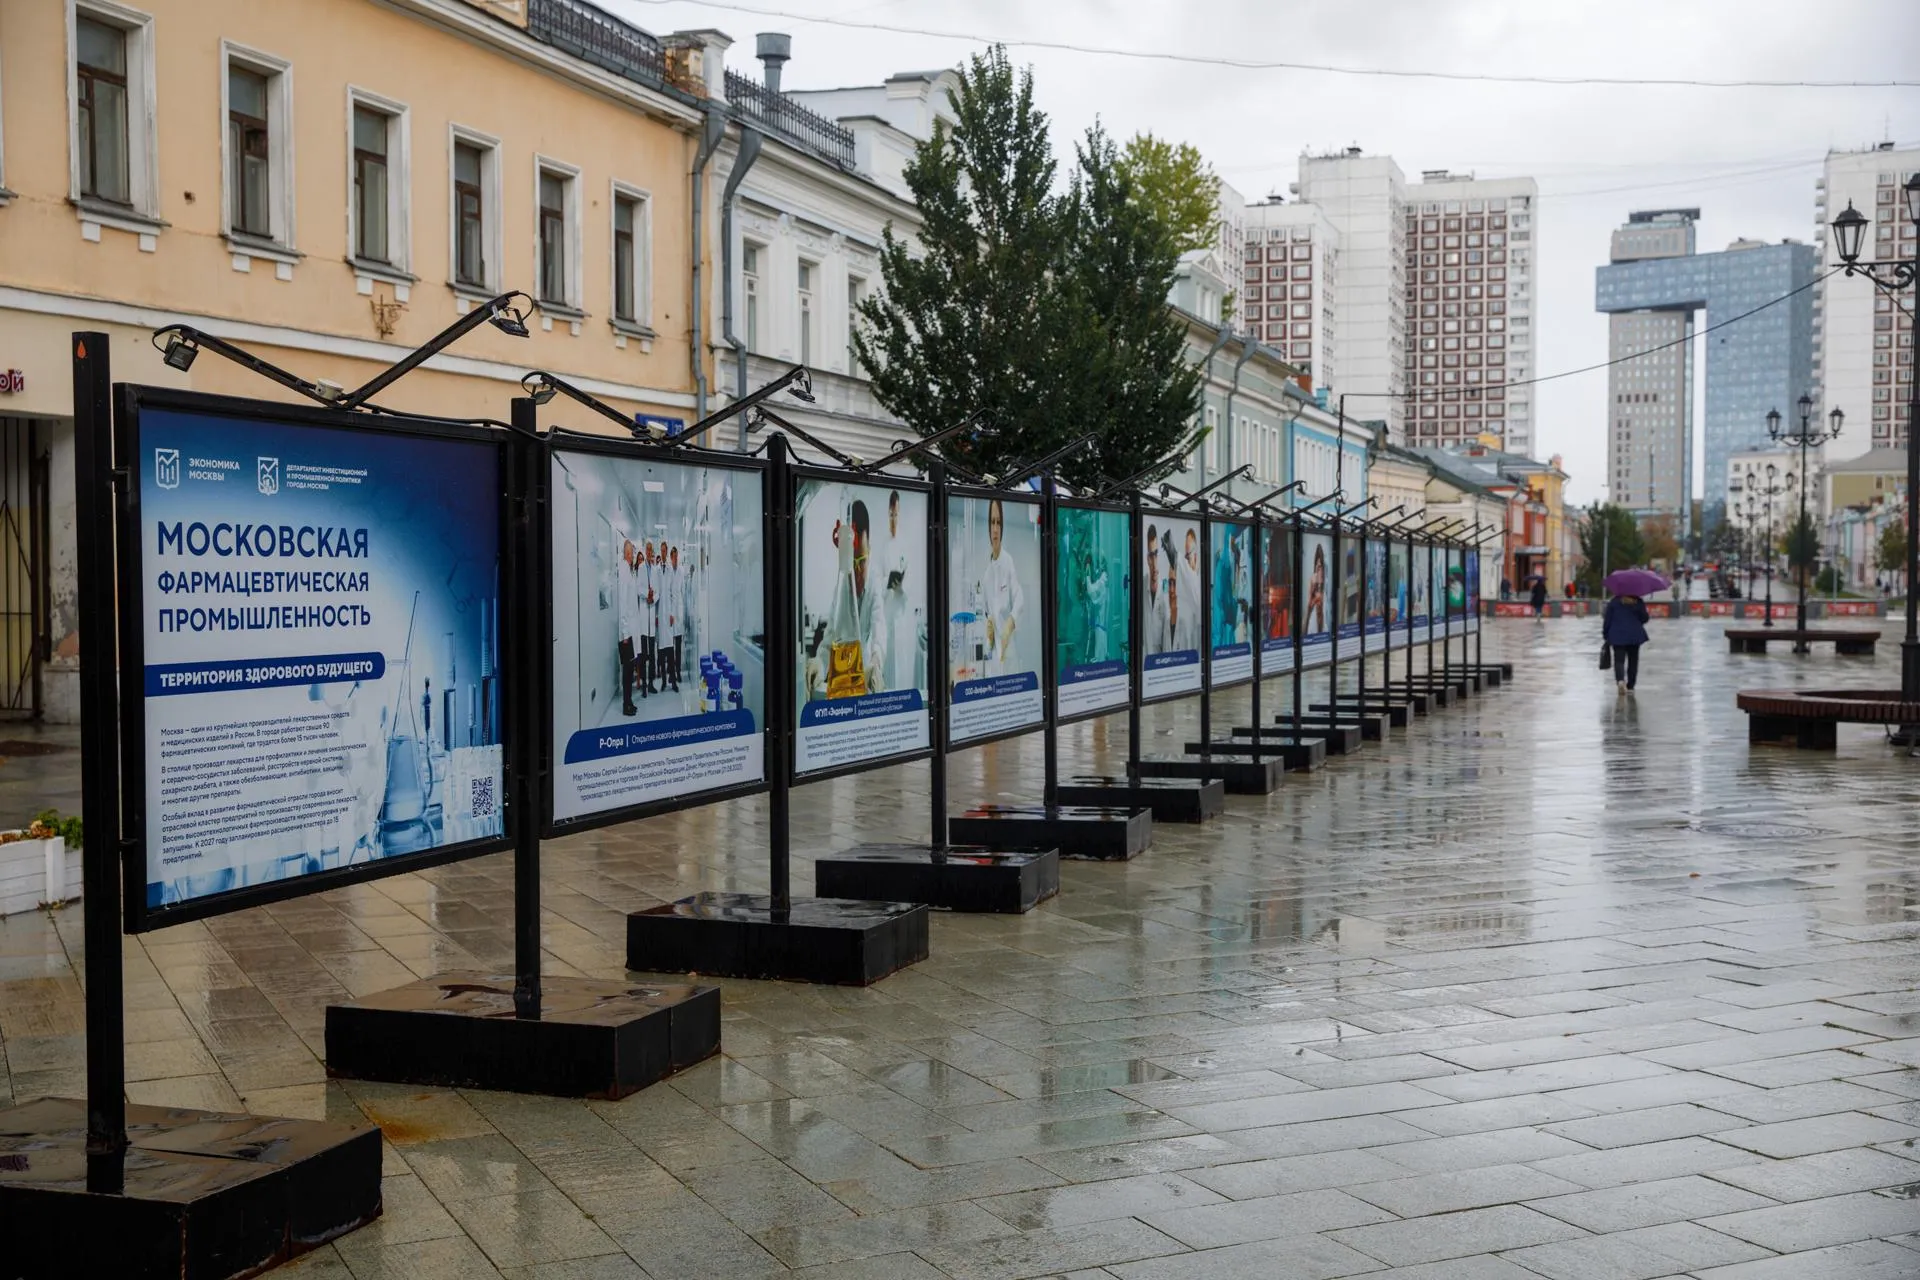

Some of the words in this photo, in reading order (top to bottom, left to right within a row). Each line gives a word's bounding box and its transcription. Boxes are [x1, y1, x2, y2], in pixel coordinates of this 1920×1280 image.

[189, 458, 240, 470] ЭКОНОМИКА
[286, 464, 322, 474] ДЕПАРТАМЕНТ
[323, 466, 368, 477] ИНВЕСТИЦИОННОЙ
[189, 471, 224, 481] МОСКВЫ
[287, 481, 307, 489] ГОРОДА
[292, 474, 335, 482] ПРОМЫШЛЕННОЙ
[336, 476, 361, 484] ПОЛИТИКИ
[157, 521, 368, 558] МОСКОВСКАЯ
[157, 571, 369, 596] ФАРМАЦЕВТИЧЕСКАЯ
[159, 605, 371, 632] ПРОМЫШЛЕННОСТЬ
[160, 669, 242, 688] ТЕРРИТОРИЯ
[245, 665, 315, 684] ЗДОРОВОГО
[317, 660, 373, 677] БУДУЩЕГО
[214, 721, 248, 731] крупнейших
[249, 716, 292, 728] производителей
[293, 714, 330, 723] лекарственных
[331, 712, 350, 720] средств
[166, 736, 205, 746] медицинских
[206, 732, 230, 741] изделий
[280, 726, 305, 735] работают
[600, 737, 623, 748] Р-Опра
[632, 735, 655, 744] Открытие
[161, 745, 217, 758] фармацевтических
[218, 741, 246, 750] компаний,
[257, 738, 280, 747] трудятся
[166, 770, 230, 784] сердечно-сосудистых
[231, 764, 267, 775] заболеваний,
[267, 760, 299, 771] расстройств
[300, 756, 322, 766] нервной
[167, 765, 192, 773] столице
[192, 760, 226, 771] производят
[226, 757, 254, 765] лекарства
[265, 751, 303, 762] профилактики
[161, 785, 192, 795] сахарного
[193, 782, 218, 791] диабета,
[240, 772, 287, 783] обезболивающие,
[162, 811, 186, 821] Особый
[187, 809, 205, 817] вклад
[210, 805, 236, 815] развитие
[236, 796, 287, 811] фармацевтической
[288, 794, 308, 802] отрасли
[309, 791, 326, 799] города
[327, 788, 344, 796] вносит
[167, 796, 188, 804] многие
[189, 793, 210, 802] другие
[210, 789, 242, 799] препараты.
[162, 820, 197, 833] отраслевой
[198, 818, 221, 826] кластер
[222, 810, 258, 823] предприятий
[266, 805, 302, 816] производству
[302, 799, 335, 809] современных
[162, 834, 185, 843] Восемь
[186, 823, 248, 839] высокотехнологичных
[249, 815, 296, 830] фармпроизводств
[297, 811, 321, 820] мирового
[321, 808, 339, 817] уровня
[339, 806, 349, 814] уже
[163, 843, 193, 853] запущены.
[200, 838, 215, 847] 2027
[229, 830, 270, 842] запланировано
[304, 820, 326, 828] кластера
[163, 850, 203, 864] предприятий.
